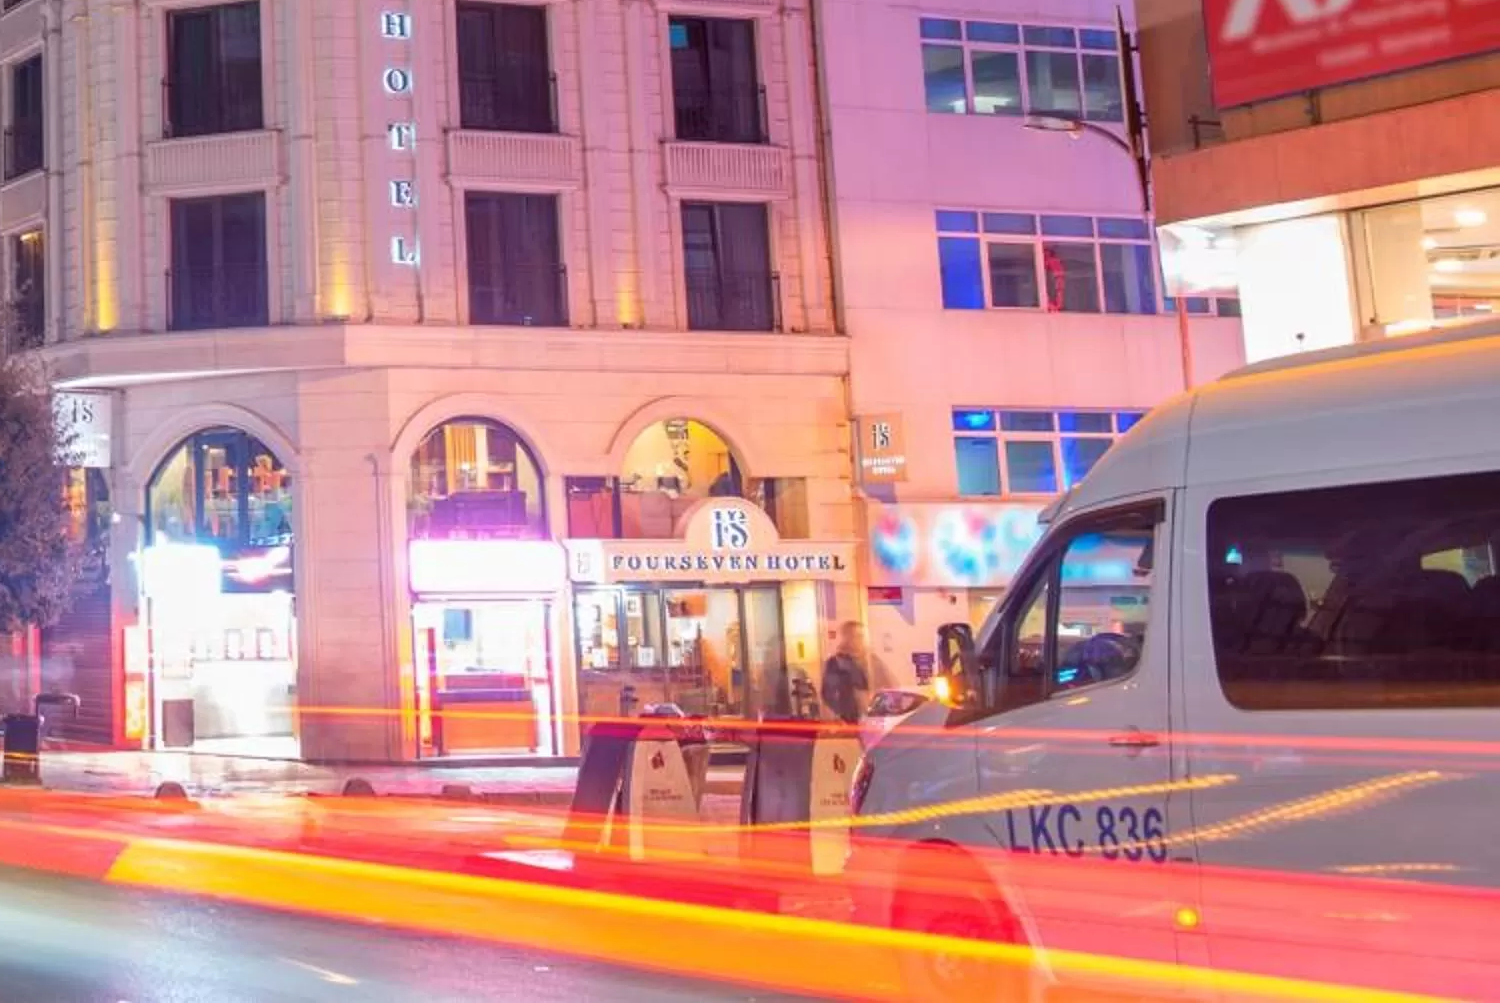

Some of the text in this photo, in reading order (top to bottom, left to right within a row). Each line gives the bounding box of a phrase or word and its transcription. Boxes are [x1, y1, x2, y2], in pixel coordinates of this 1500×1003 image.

[381, 11, 421, 265] HOTEL
[611, 553, 847, 572] FOURSEVEN HOTEL
[1006, 804, 1168, 864] LKC 836
